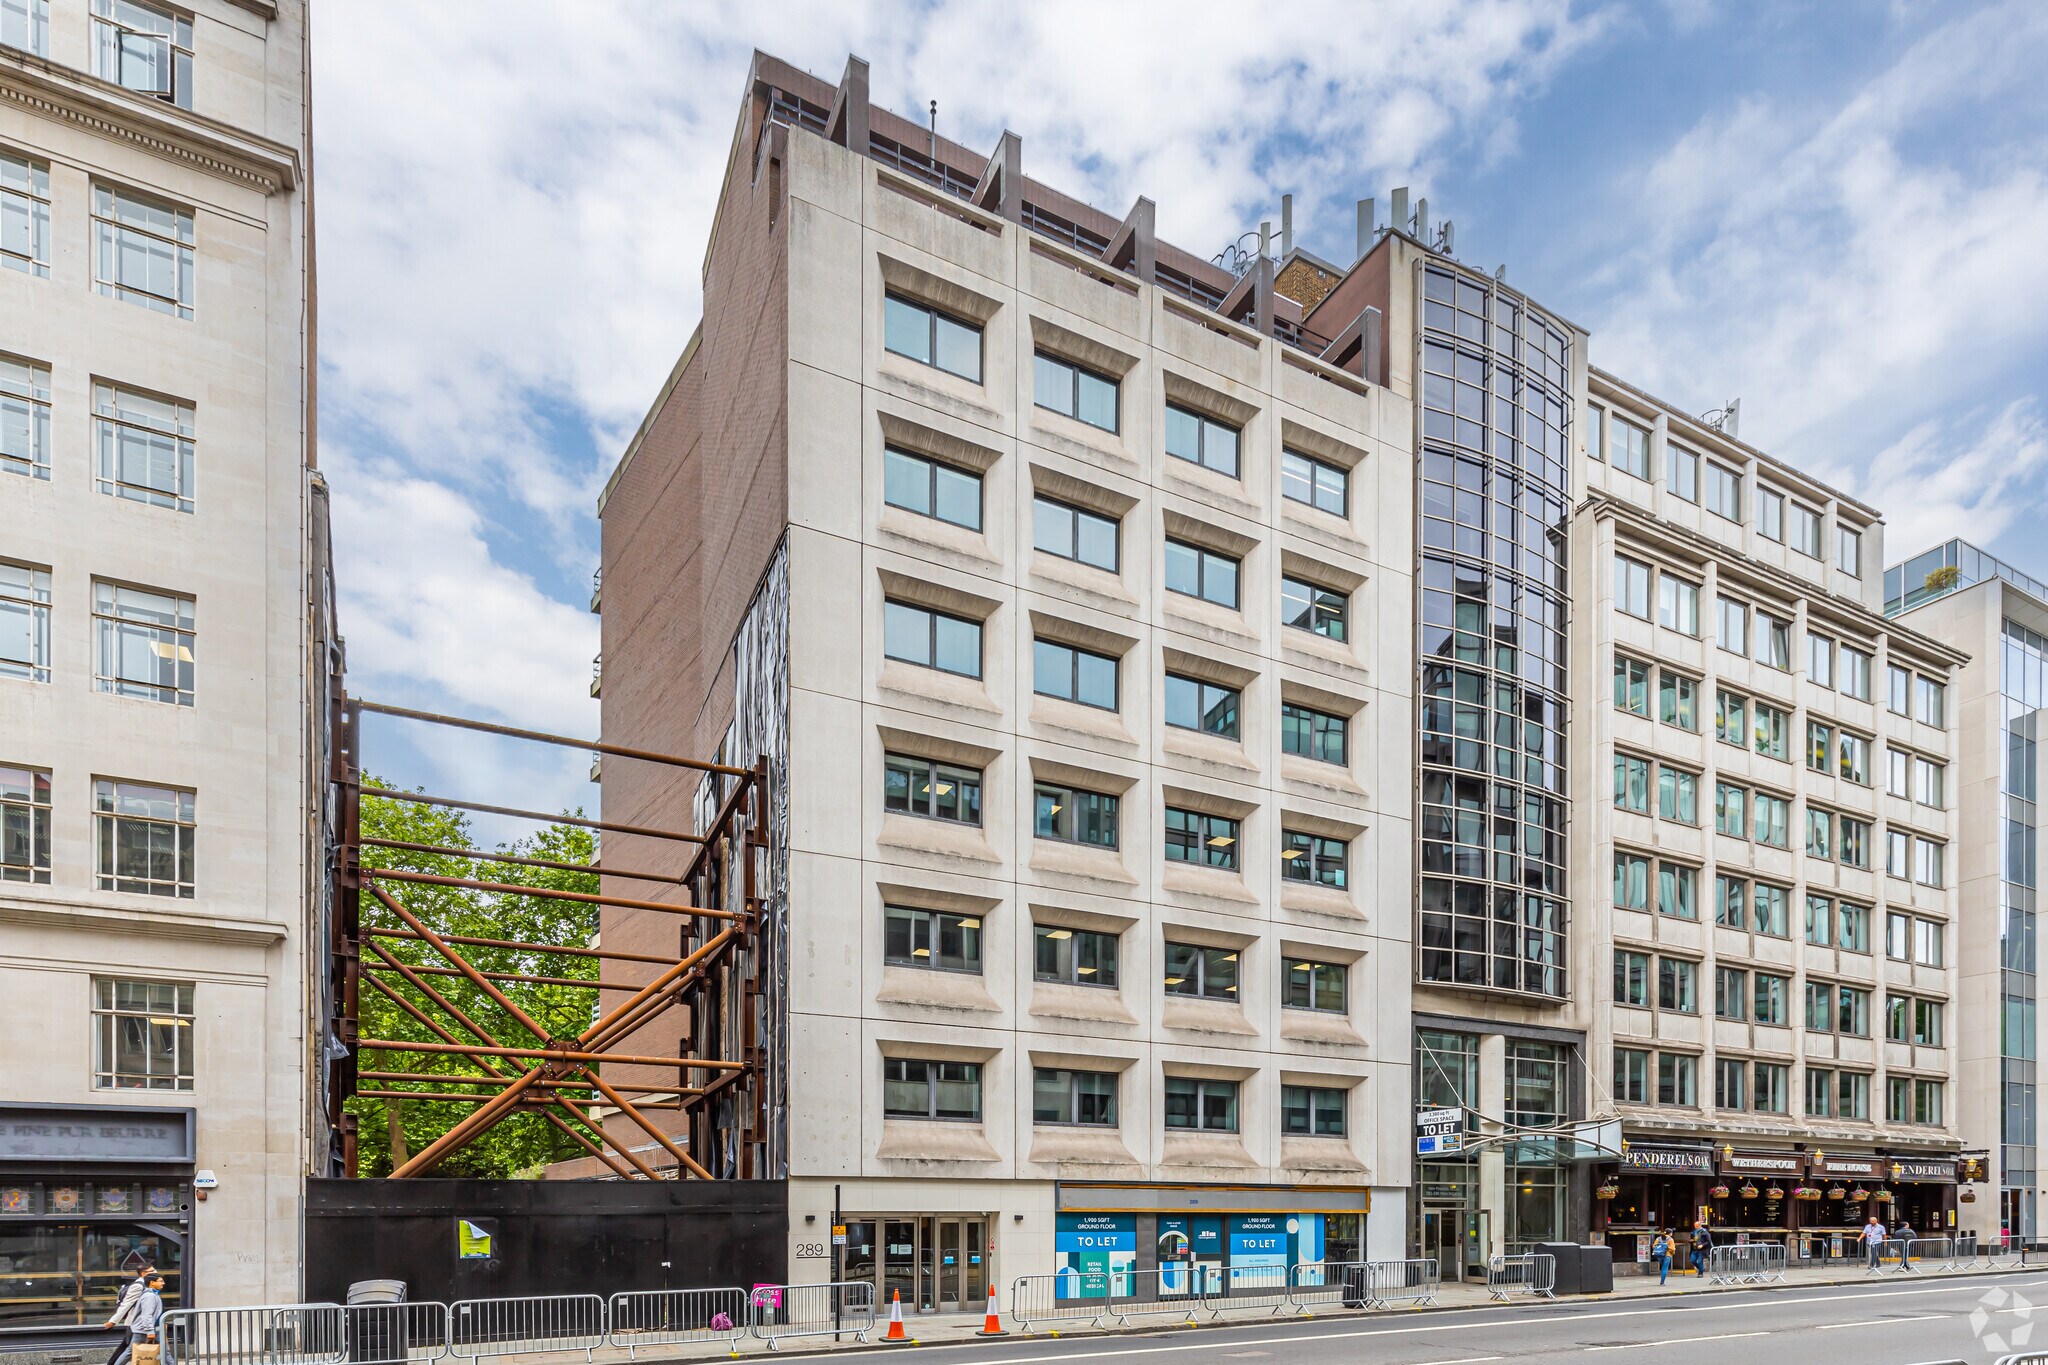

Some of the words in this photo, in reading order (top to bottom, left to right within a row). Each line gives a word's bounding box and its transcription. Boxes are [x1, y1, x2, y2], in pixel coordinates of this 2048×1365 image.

[1423, 1125, 1436, 1136] TO
[1438, 1123, 1455, 1134] LET
[1626, 1152, 1694, 1166] PENDEREL'S
[1694, 1155, 1710, 1166] OAK
[1731, 1158, 1797, 1169] WETHERSPOON
[1847, 1164, 1872, 1172] HOUSE
[1901, 1164, 1945, 1176] ENDEREL'S
[1078, 1237, 1093, 1246] TO
[1097, 1237, 1117, 1246] LET
[1243, 1240, 1256, 1248] TO
[1259, 1240, 1275, 1248] LET
[796, 1244, 823, 1256] 289
